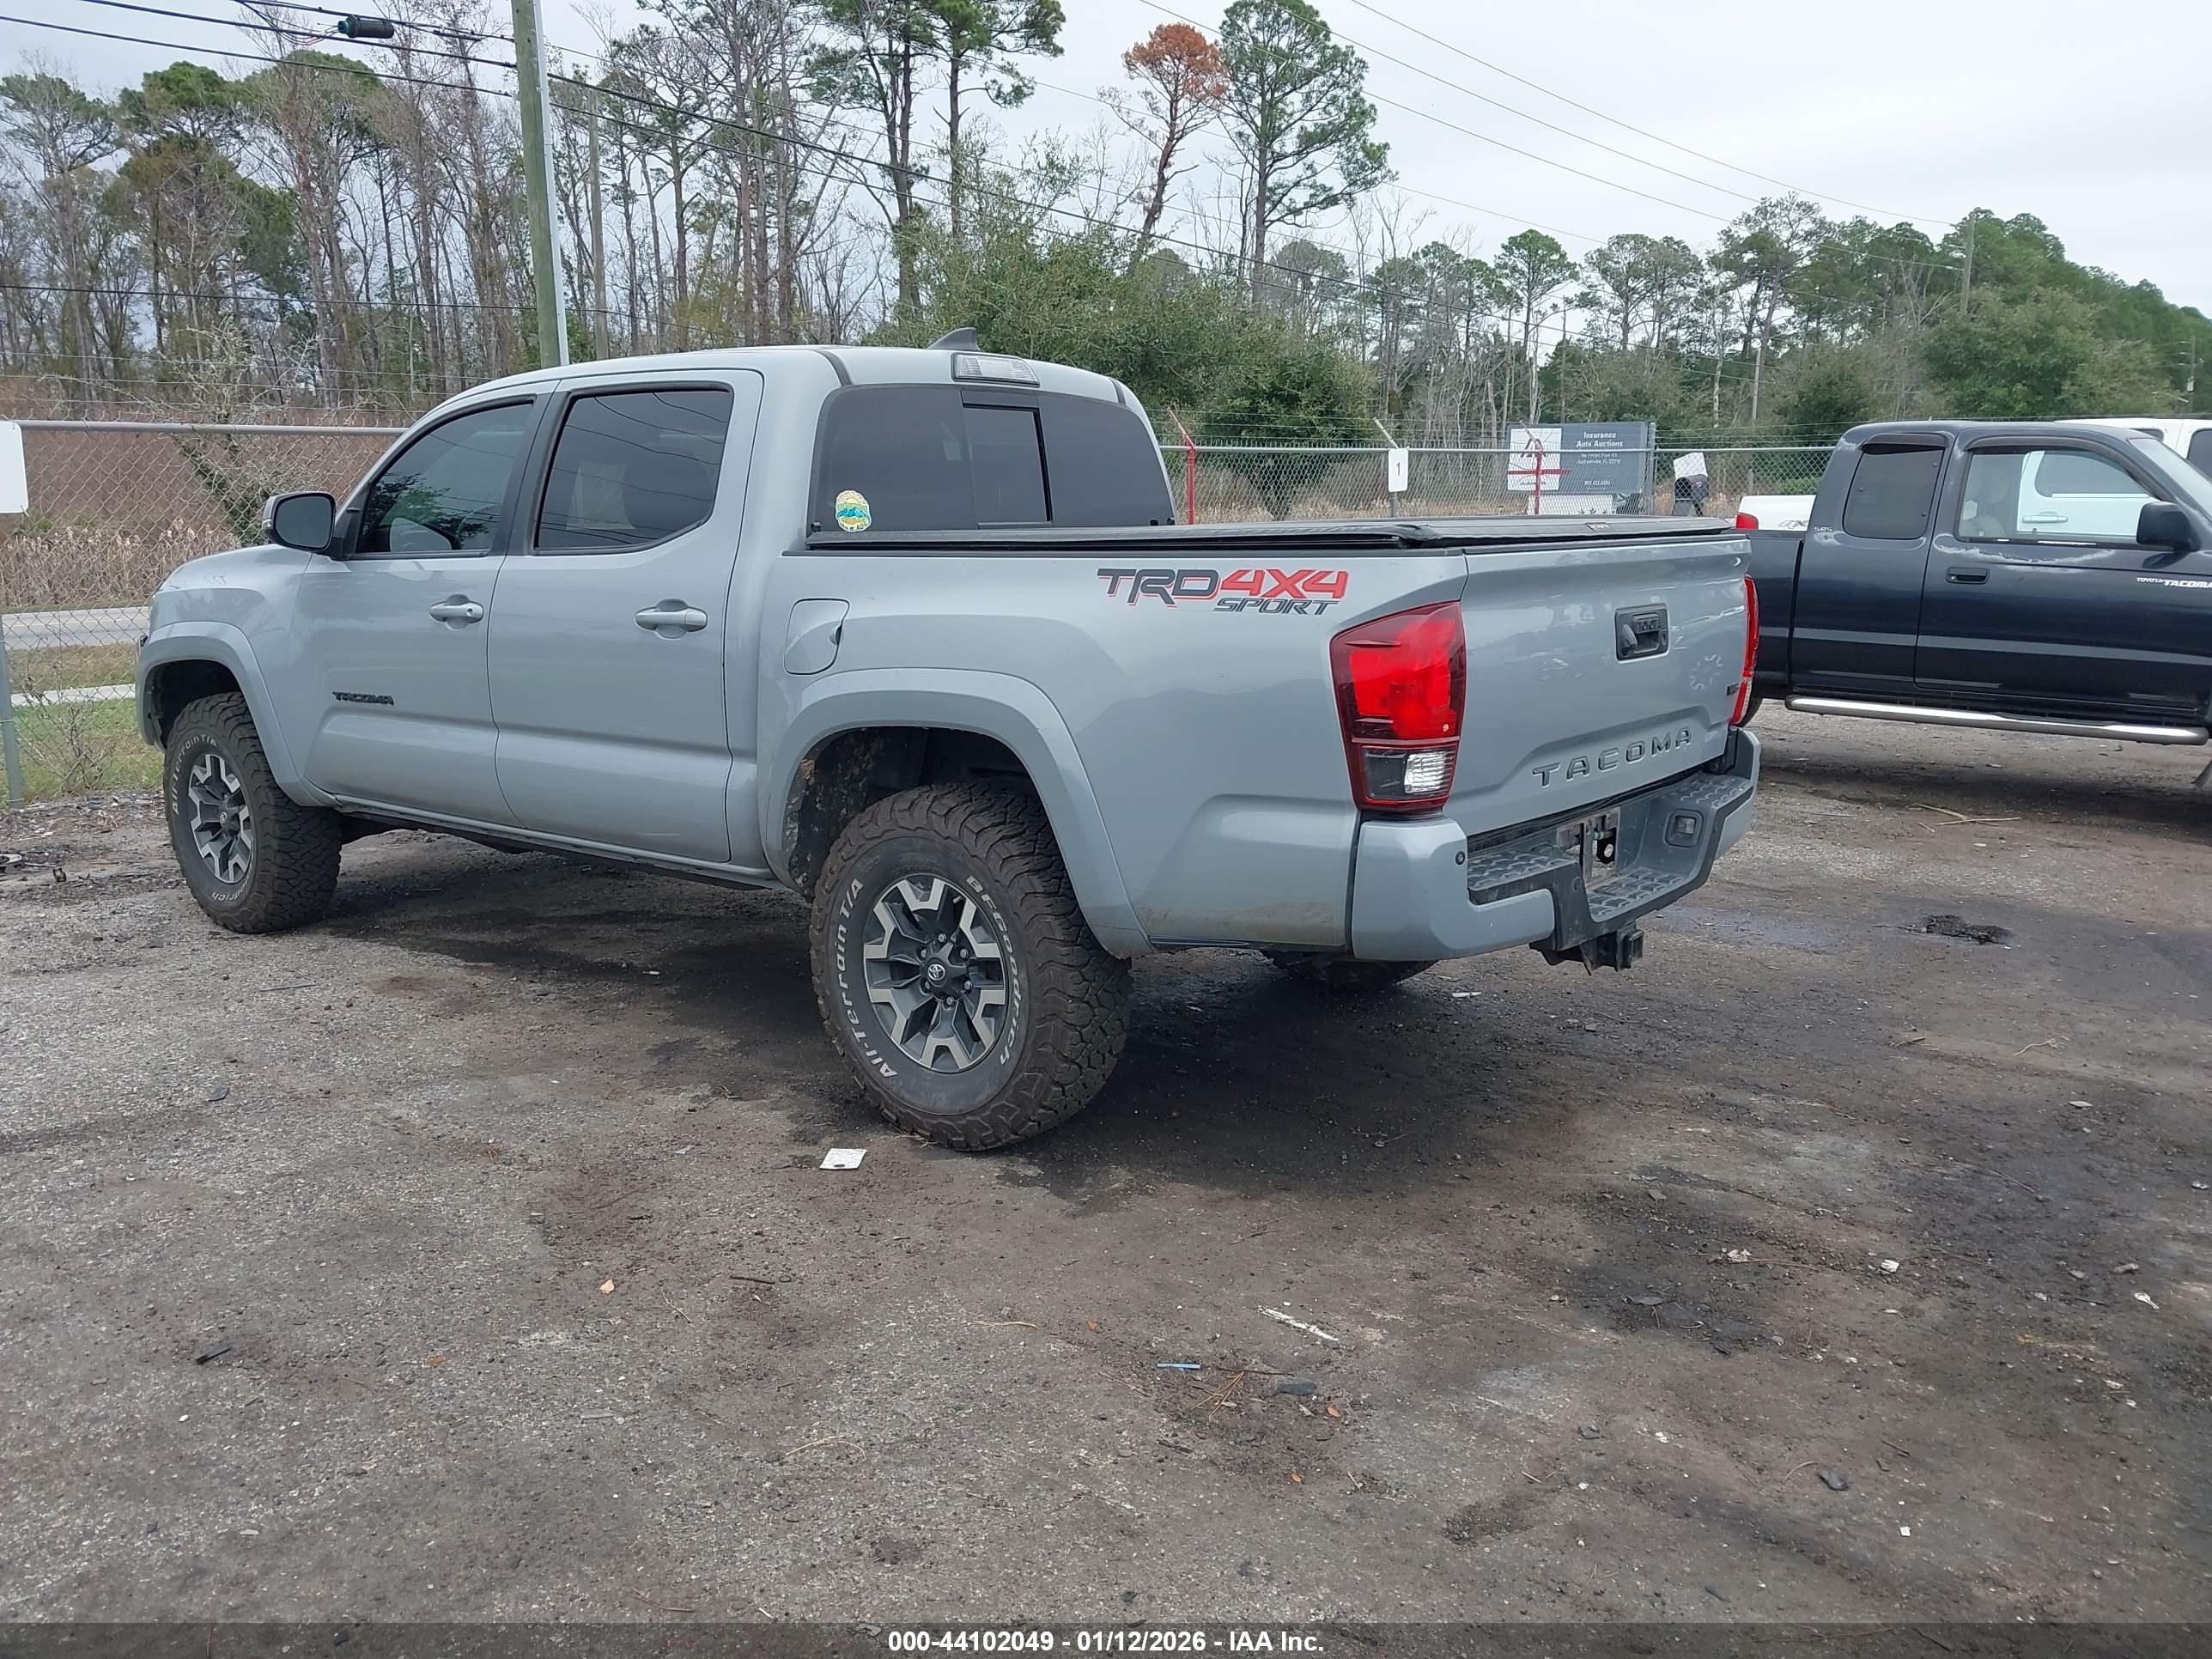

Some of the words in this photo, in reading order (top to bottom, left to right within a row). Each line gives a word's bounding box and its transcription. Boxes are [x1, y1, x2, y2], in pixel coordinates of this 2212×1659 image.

[1593, 439, 1624, 447] Auctions
[1097, 568, 1220, 608] TRD
[1220, 568, 1350, 599] 4X4
[1212, 598, 1340, 616] SPORT
[1532, 727, 1692, 787] TACOMA
[839, 878, 865, 920] T/A
[834, 925, 899, 1077] All-Terrain
